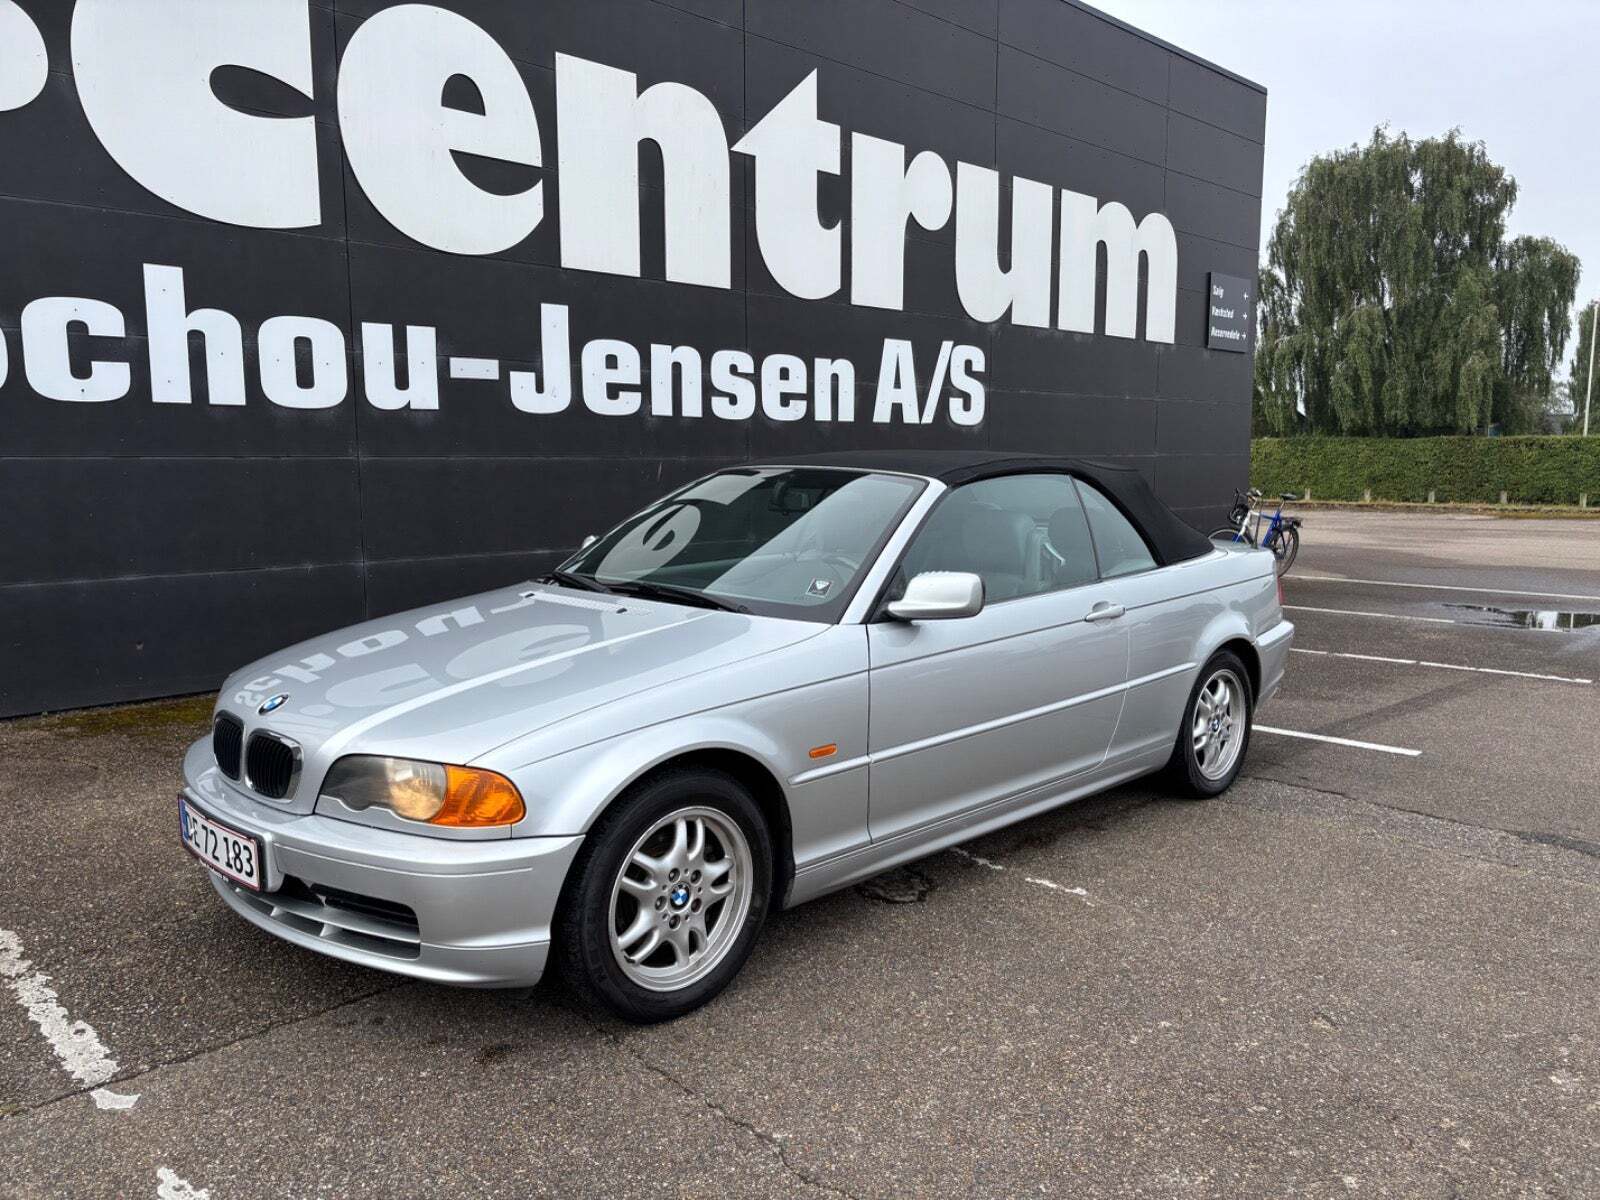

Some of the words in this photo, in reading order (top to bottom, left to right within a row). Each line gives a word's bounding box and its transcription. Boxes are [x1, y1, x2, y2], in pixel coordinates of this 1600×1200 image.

[0, 263, 855, 421] chou-Jensen
[873, 339, 985, 426] A/S
[202, 824, 219, 862] 72
[223, 836, 254, 878] 183
